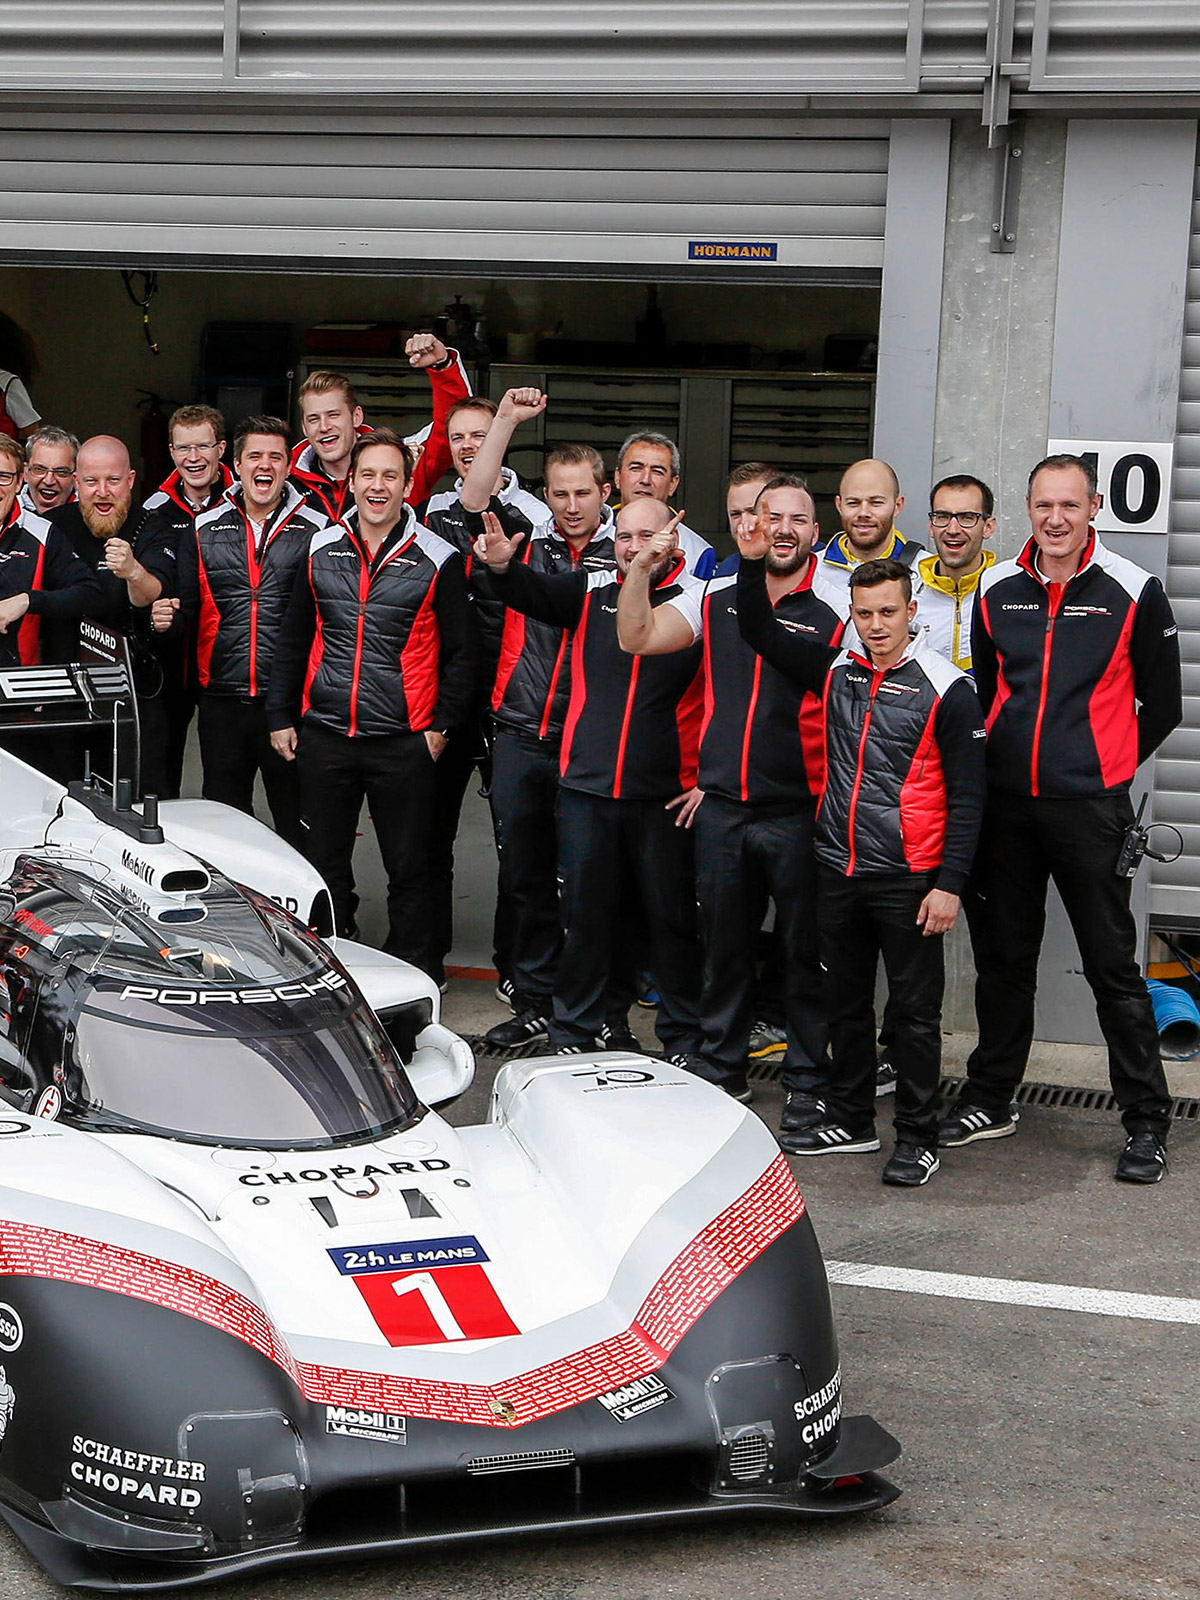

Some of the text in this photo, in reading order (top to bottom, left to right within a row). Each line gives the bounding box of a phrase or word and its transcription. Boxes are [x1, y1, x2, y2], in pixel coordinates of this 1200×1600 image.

[694, 244, 772, 257] HÖRMANN
[601, 605, 618, 614] CHOP
[1001, 603, 1040, 611] CHOPARD
[1064, 605, 1108, 613] PORSCHE
[80, 621, 117, 650] CHOPARD
[881, 680, 920, 693] PORSCHE
[120, 970, 348, 1005] PORSCHE
[583, 1082, 690, 1093] PORSCHE
[238, 1158, 451, 1187] CHOPARD
[388, 1252, 415, 1265] LE
[416, 1246, 478, 1263] MANS
[390, 1271, 468, 1341] 1
[597, 1379, 650, 1411] Mobil
[628, 1391, 669, 1414] MICHELIN
[326, 1406, 406, 1431] Mobil 1
[802, 1395, 842, 1444] CHOPA
[349, 1426, 400, 1440] MICHELIN
[71, 1434, 207, 1482] SCHAEFFLER
[70, 1461, 202, 1509] CHOPARD
